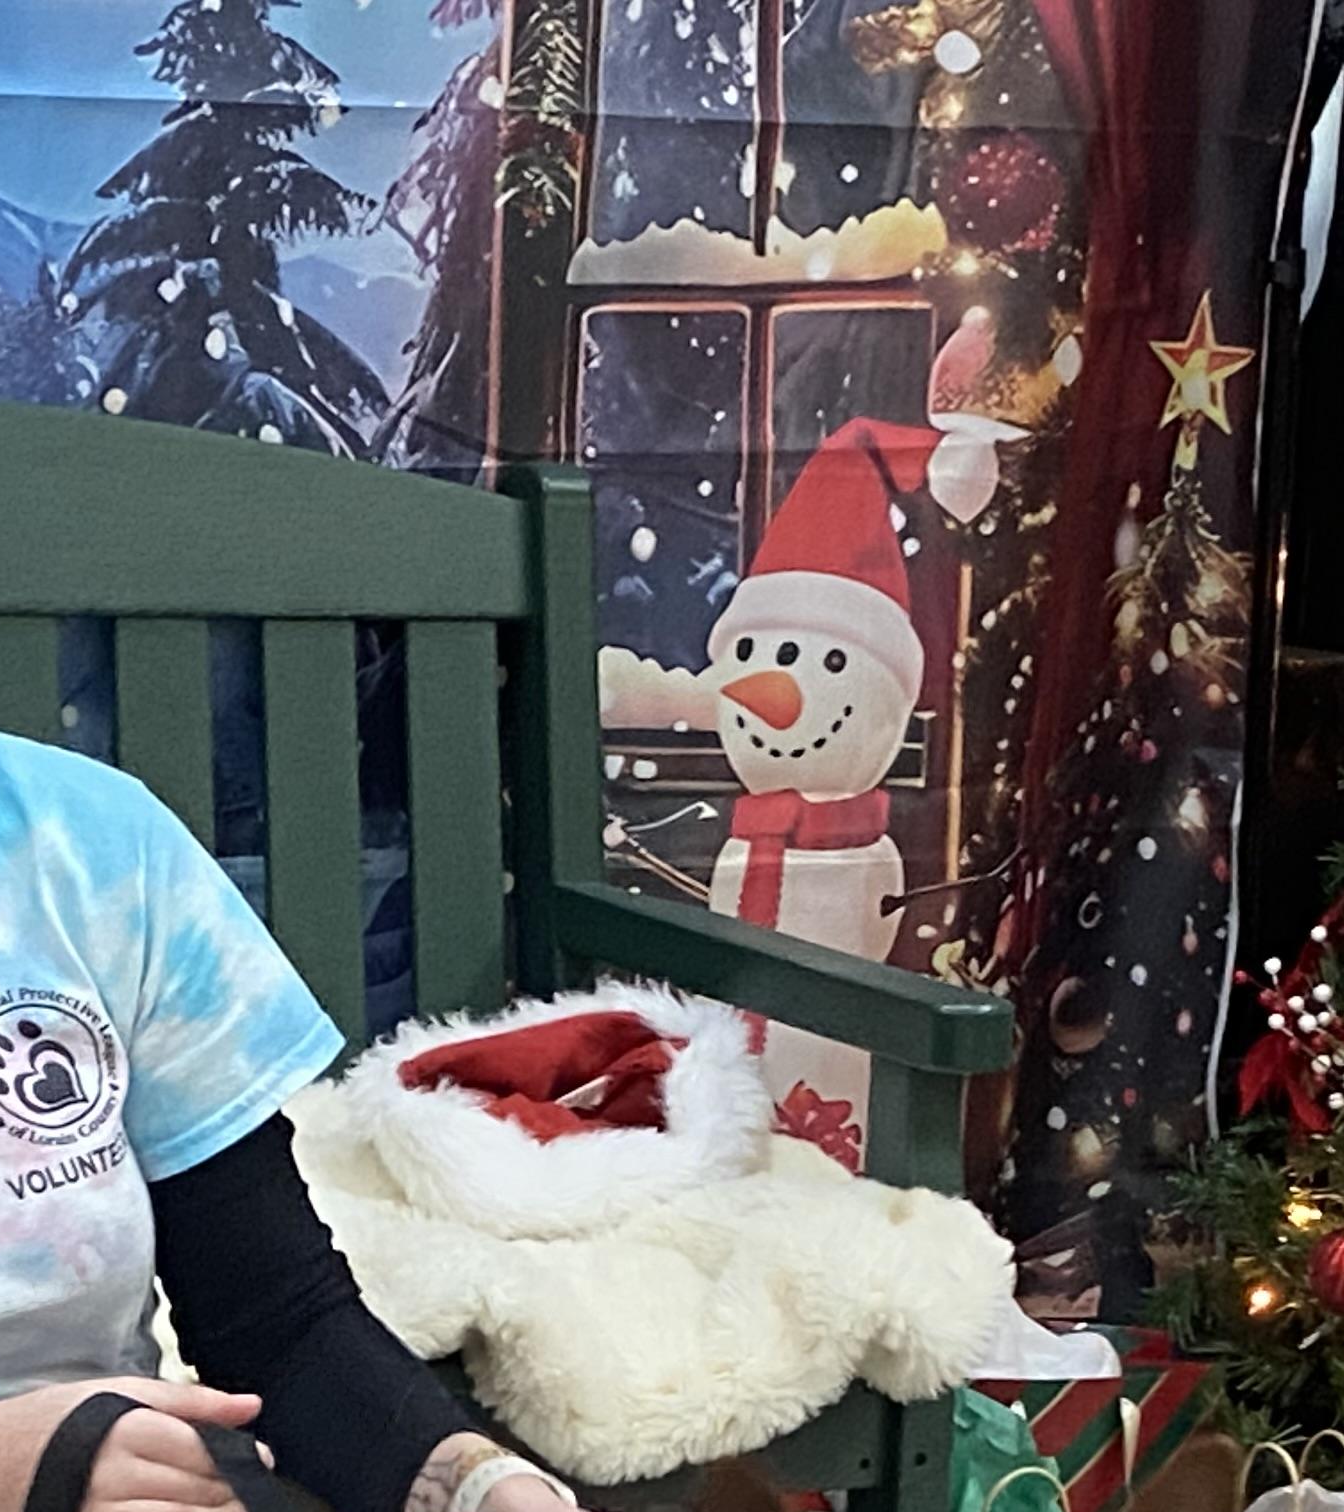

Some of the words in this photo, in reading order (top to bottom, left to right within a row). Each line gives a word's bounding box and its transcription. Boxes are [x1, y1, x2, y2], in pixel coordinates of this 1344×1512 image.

[18, 988, 102, 1023] Protective
[8, 1126, 29, 1139] of
[4, 1131, 127, 1200] VOLUNTE
